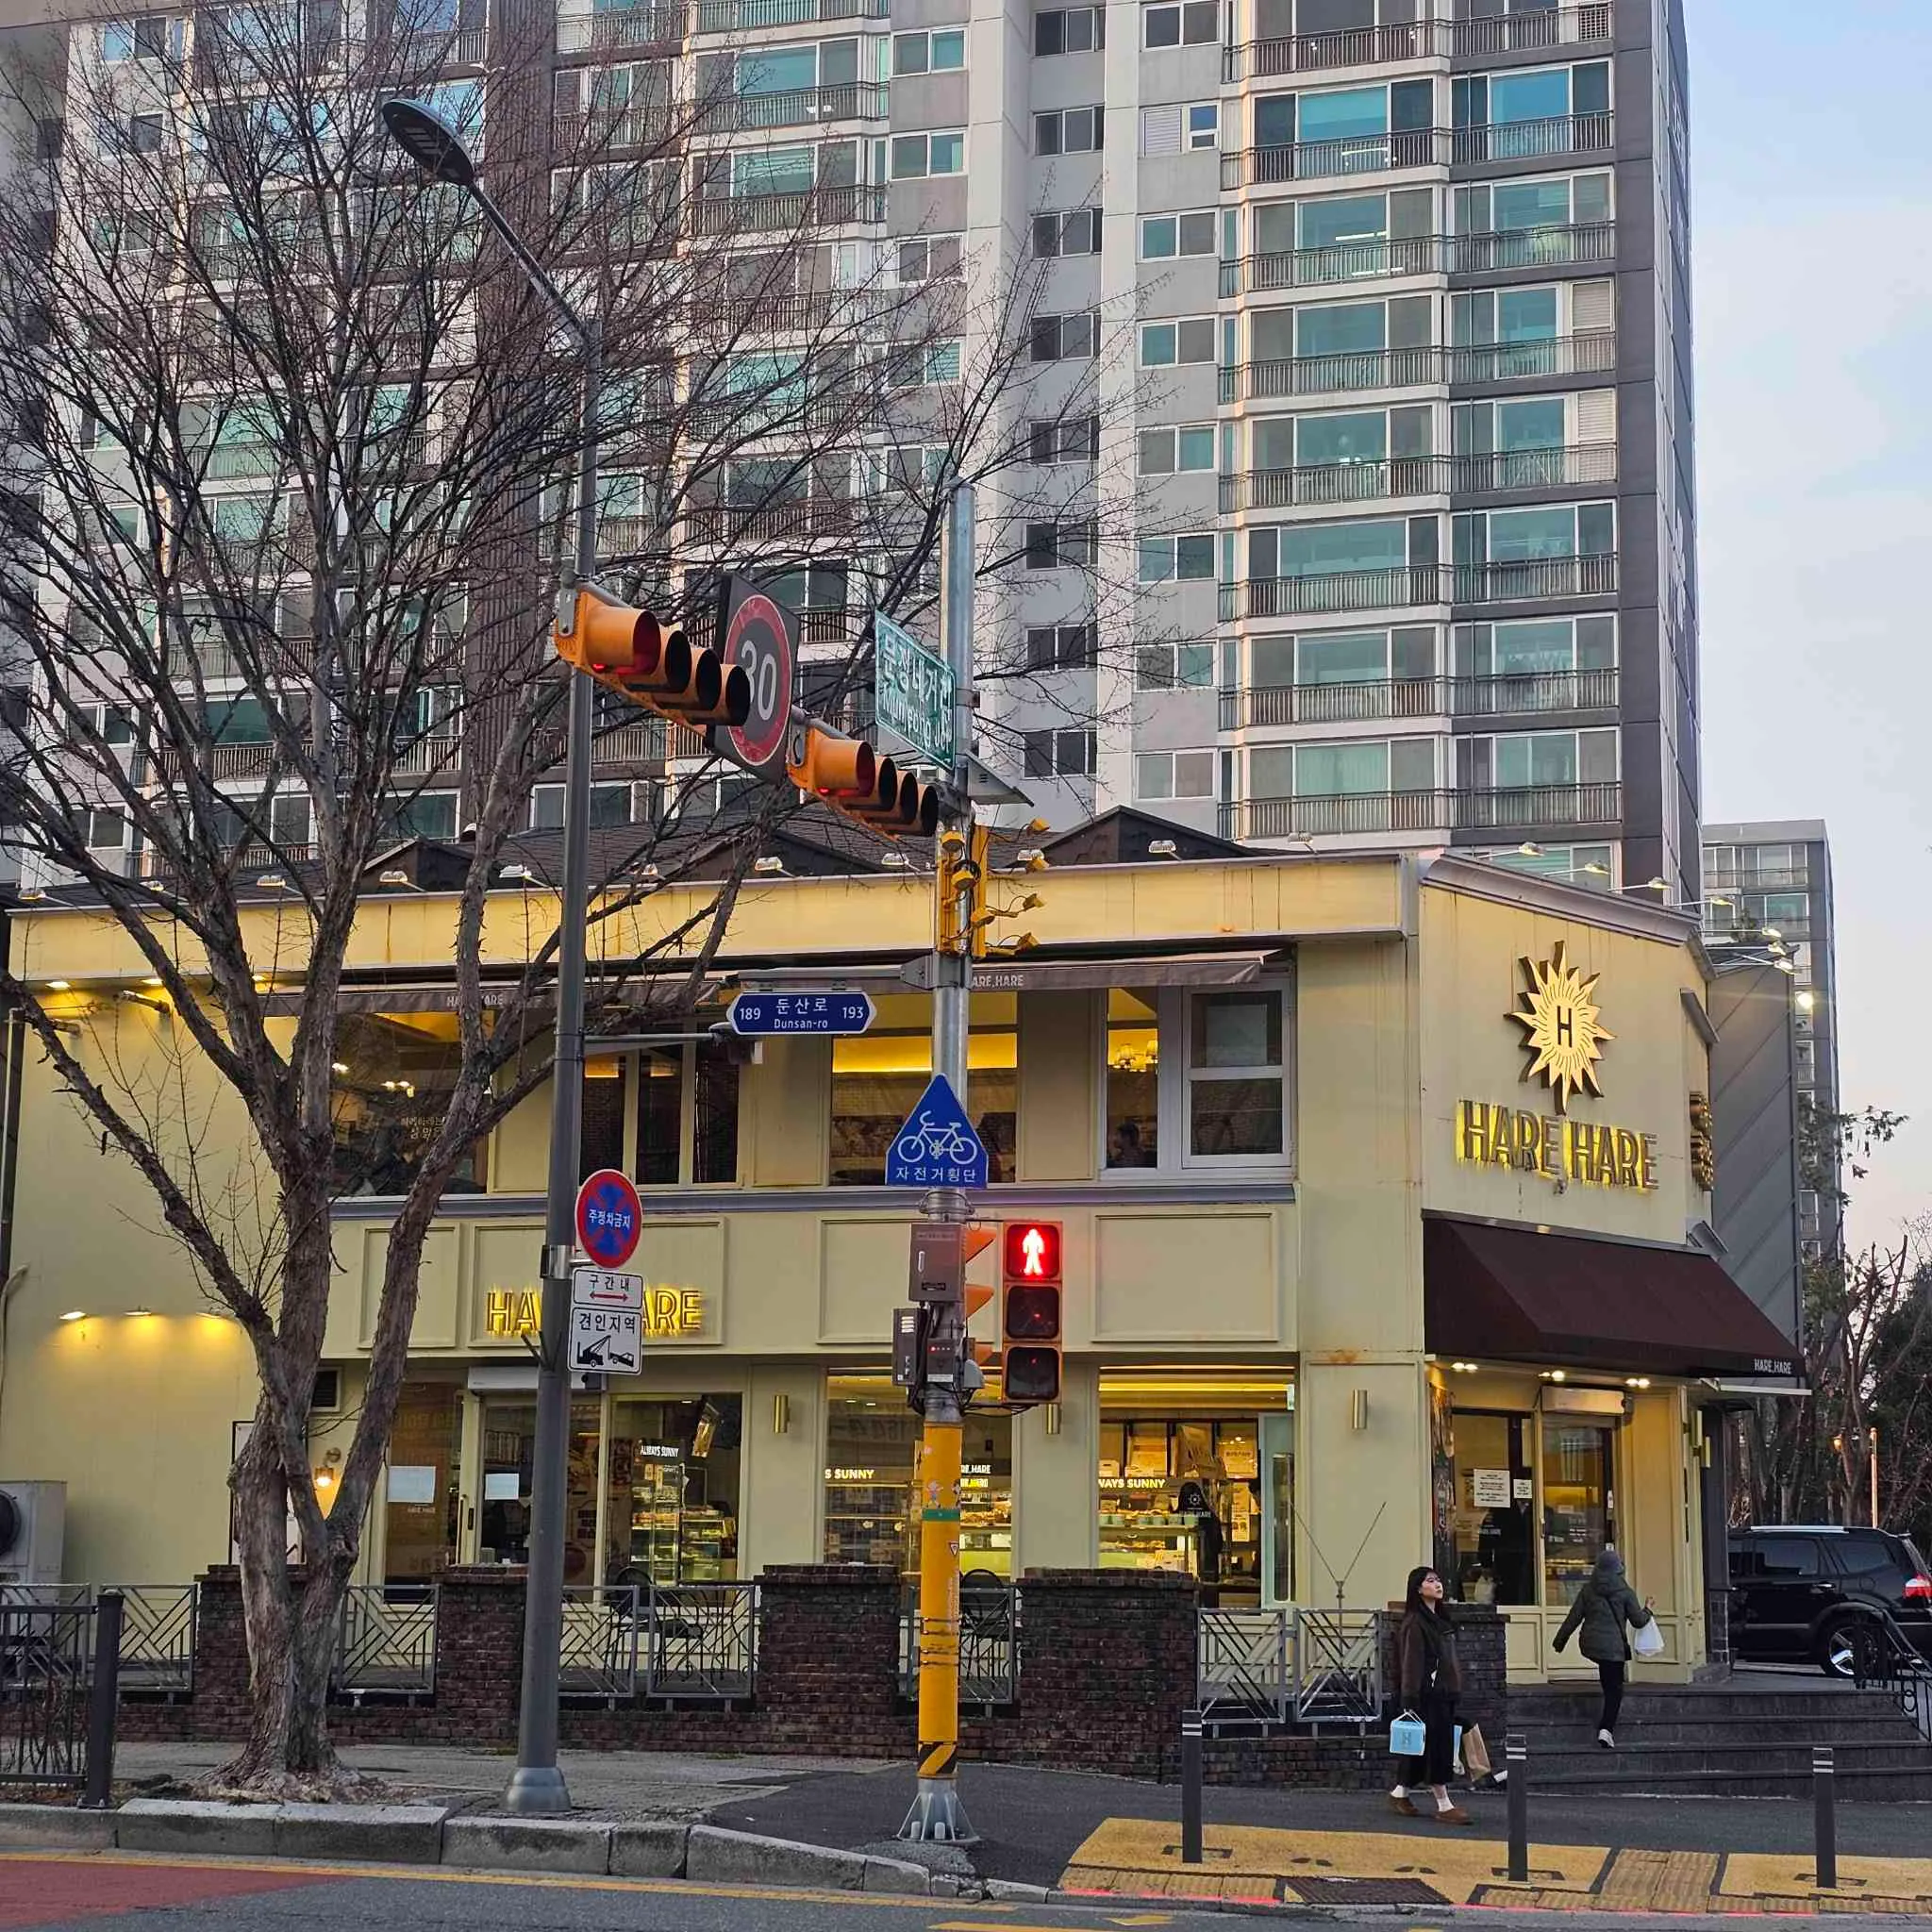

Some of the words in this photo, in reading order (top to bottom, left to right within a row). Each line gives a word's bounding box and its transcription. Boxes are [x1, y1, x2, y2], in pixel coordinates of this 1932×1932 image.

[741, 640, 777, 721] 30
[740, 1007, 761, 1021] 189
[775, 997, 828, 1015] 둔산로
[841, 1006, 864, 1020] 193
[774, 1018, 828, 1029] Dunsan-ro
[1557, 1005, 1573, 1048] H
[1458, 1099, 1561, 1176] HARE
[1568, 1120, 1659, 1191] HARE
[895, 1166, 976, 1183] 자전거횡단
[588, 1208, 631, 1229] 주정차금지
[589, 1274, 631, 1291] 구간내
[578, 1312, 636, 1334] 견인지역
[834, 1468, 874, 1480] SUNNY
[1126, 1478, 1166, 1489] SUNNY
